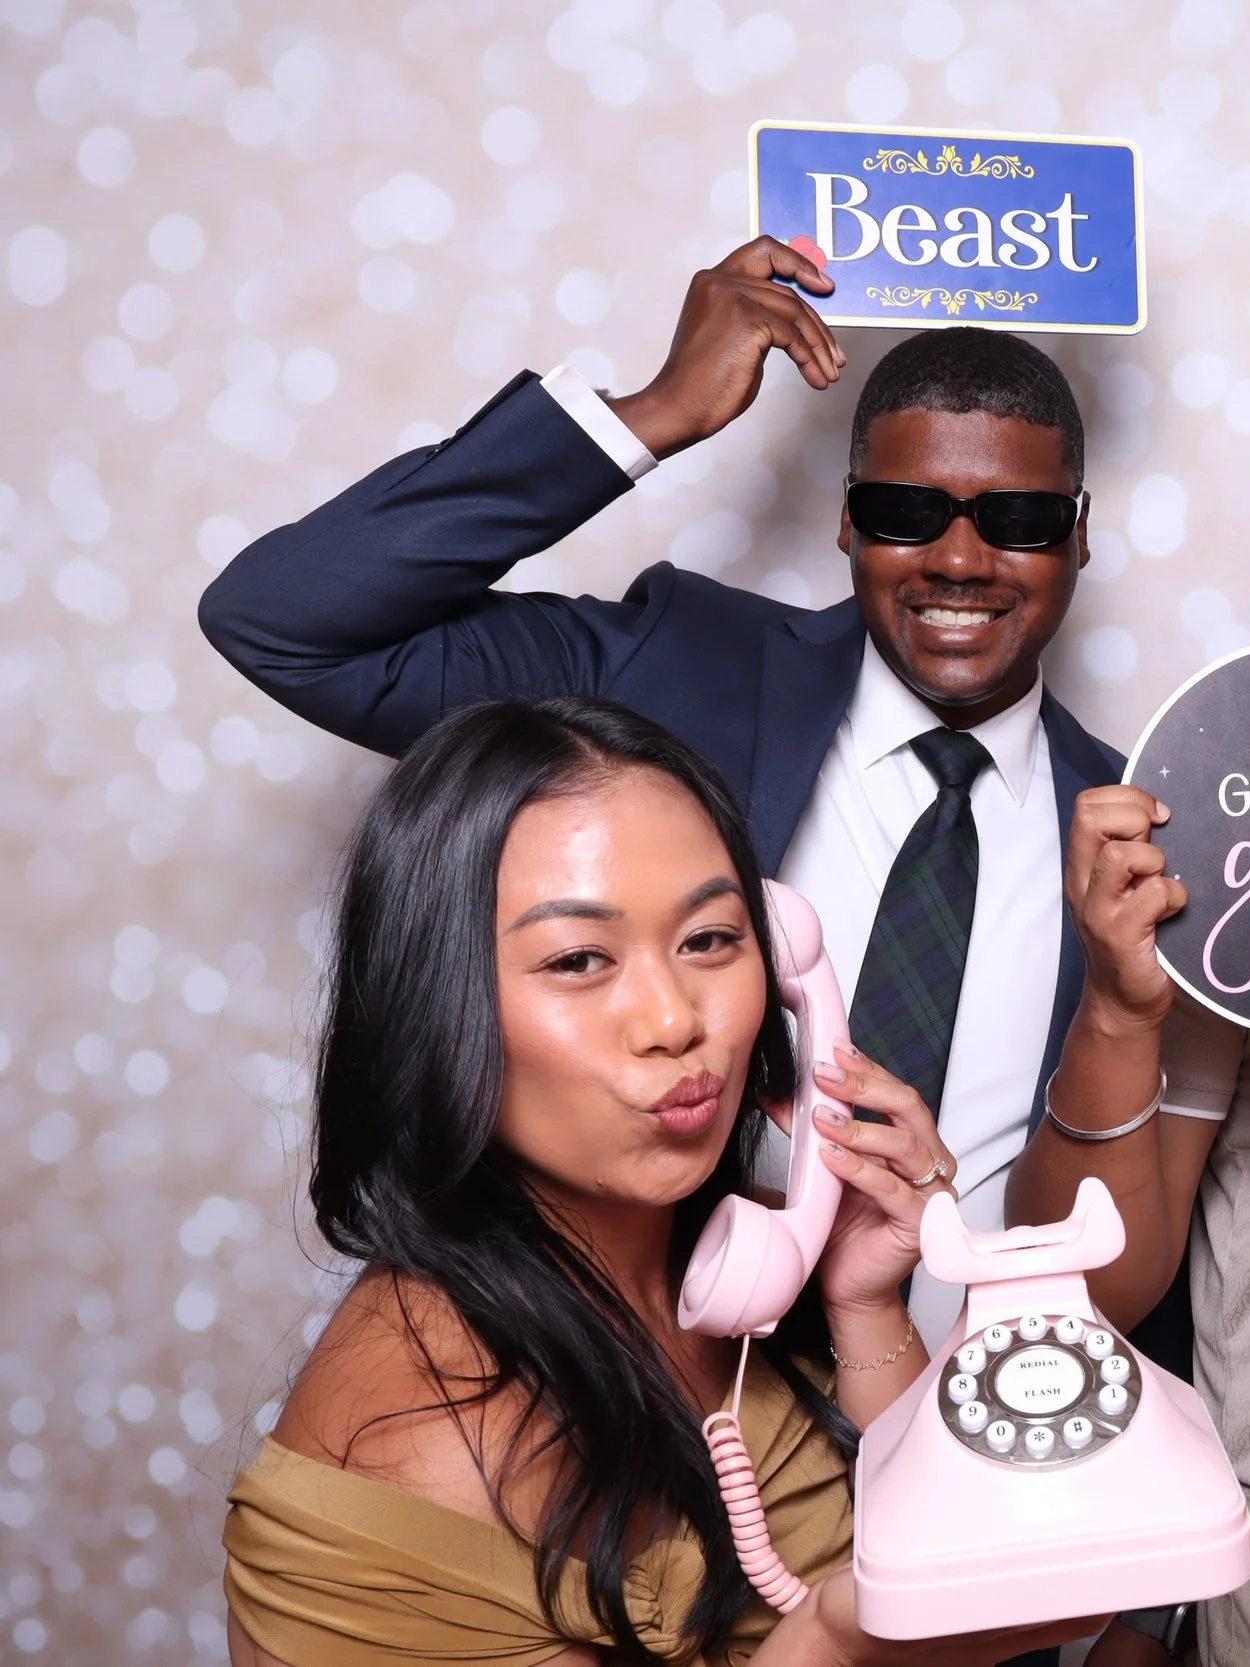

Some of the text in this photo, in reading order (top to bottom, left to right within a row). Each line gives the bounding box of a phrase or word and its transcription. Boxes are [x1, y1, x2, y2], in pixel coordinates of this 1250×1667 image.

[806, 172, 1098, 273] Beast
[1028, 1317, 1038, 1328] 5
[1066, 1320, 1075, 1330] 4
[991, 1328, 1001, 1339] 6
[1096, 1334, 1106, 1345] 3
[967, 1350, 976, 1361] 7
[1019, 1359, 1061, 1369] REDIAL
[1111, 1359, 1121, 1370] 2
[958, 1378, 968, 1389] 8
[1024, 1387, 1061, 1398] FLASH
[1110, 1388, 1117, 1399] 1
[968, 1406, 978, 1418] 9
[996, 1425, 1006, 1437] 0
